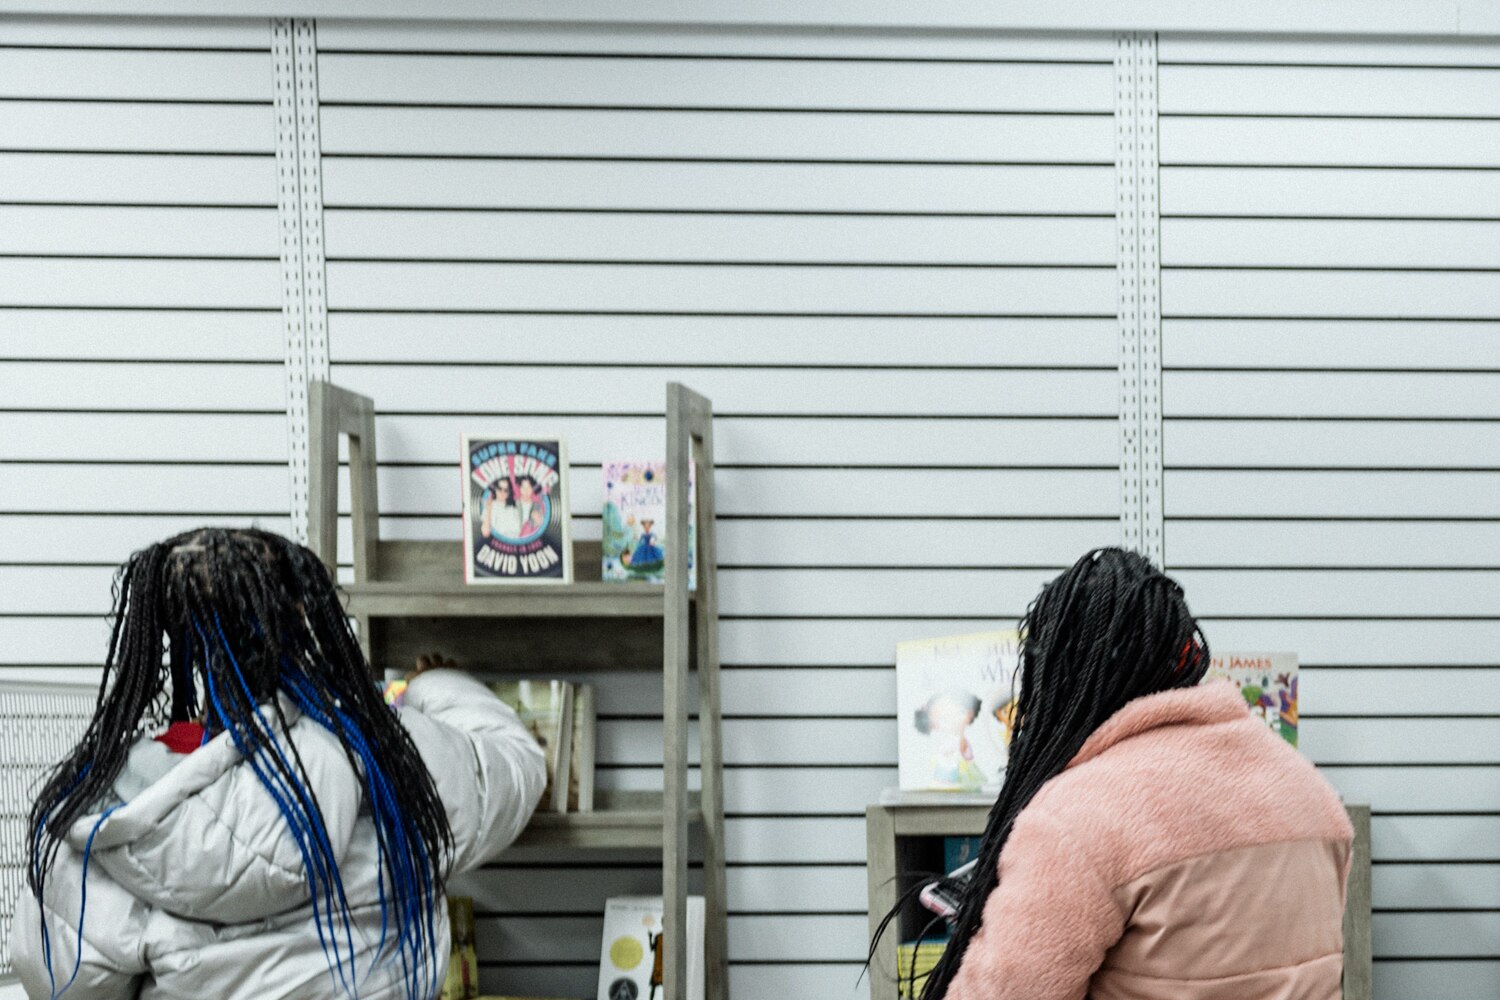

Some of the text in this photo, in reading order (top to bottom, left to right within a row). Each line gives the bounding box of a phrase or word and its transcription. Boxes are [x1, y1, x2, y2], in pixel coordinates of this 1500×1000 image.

[476, 543, 518, 575] DAVID
[520, 545, 559, 575] YOON
[1228, 656, 1272, 671] JAMES
